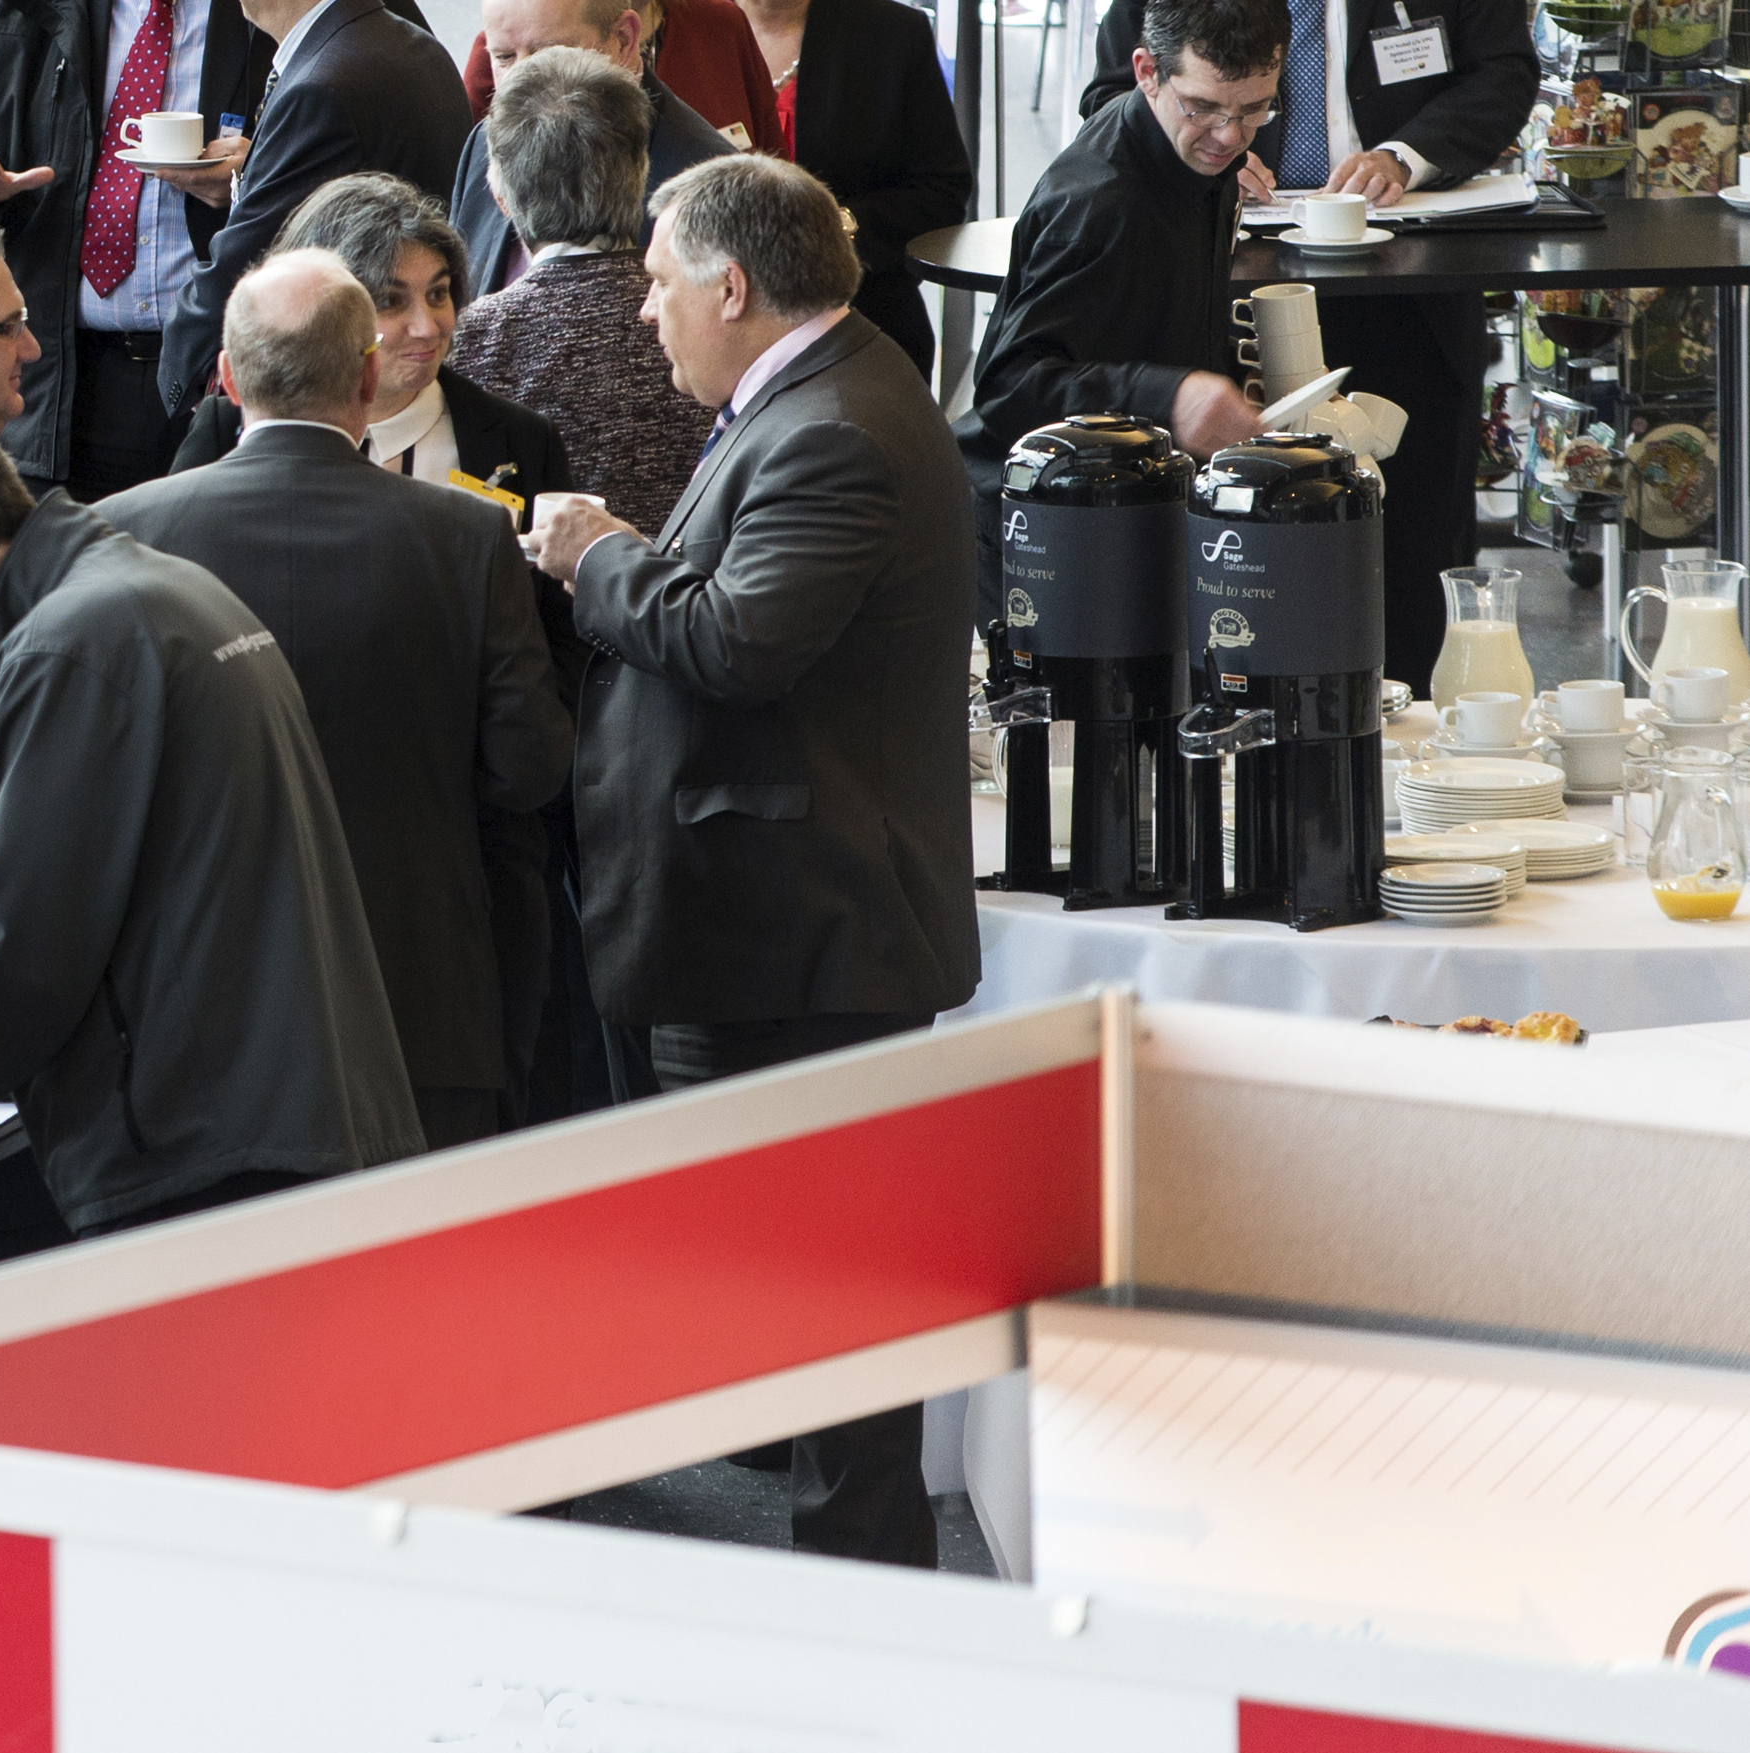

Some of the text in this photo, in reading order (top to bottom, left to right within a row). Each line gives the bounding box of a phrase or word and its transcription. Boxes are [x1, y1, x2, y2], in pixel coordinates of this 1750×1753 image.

[1223, 551, 1244, 563] Sage
[1223, 562, 1266, 573] Gateshead
[1027, 568, 1056, 581] serve
[1197, 576, 1276, 600] Proud to serve
